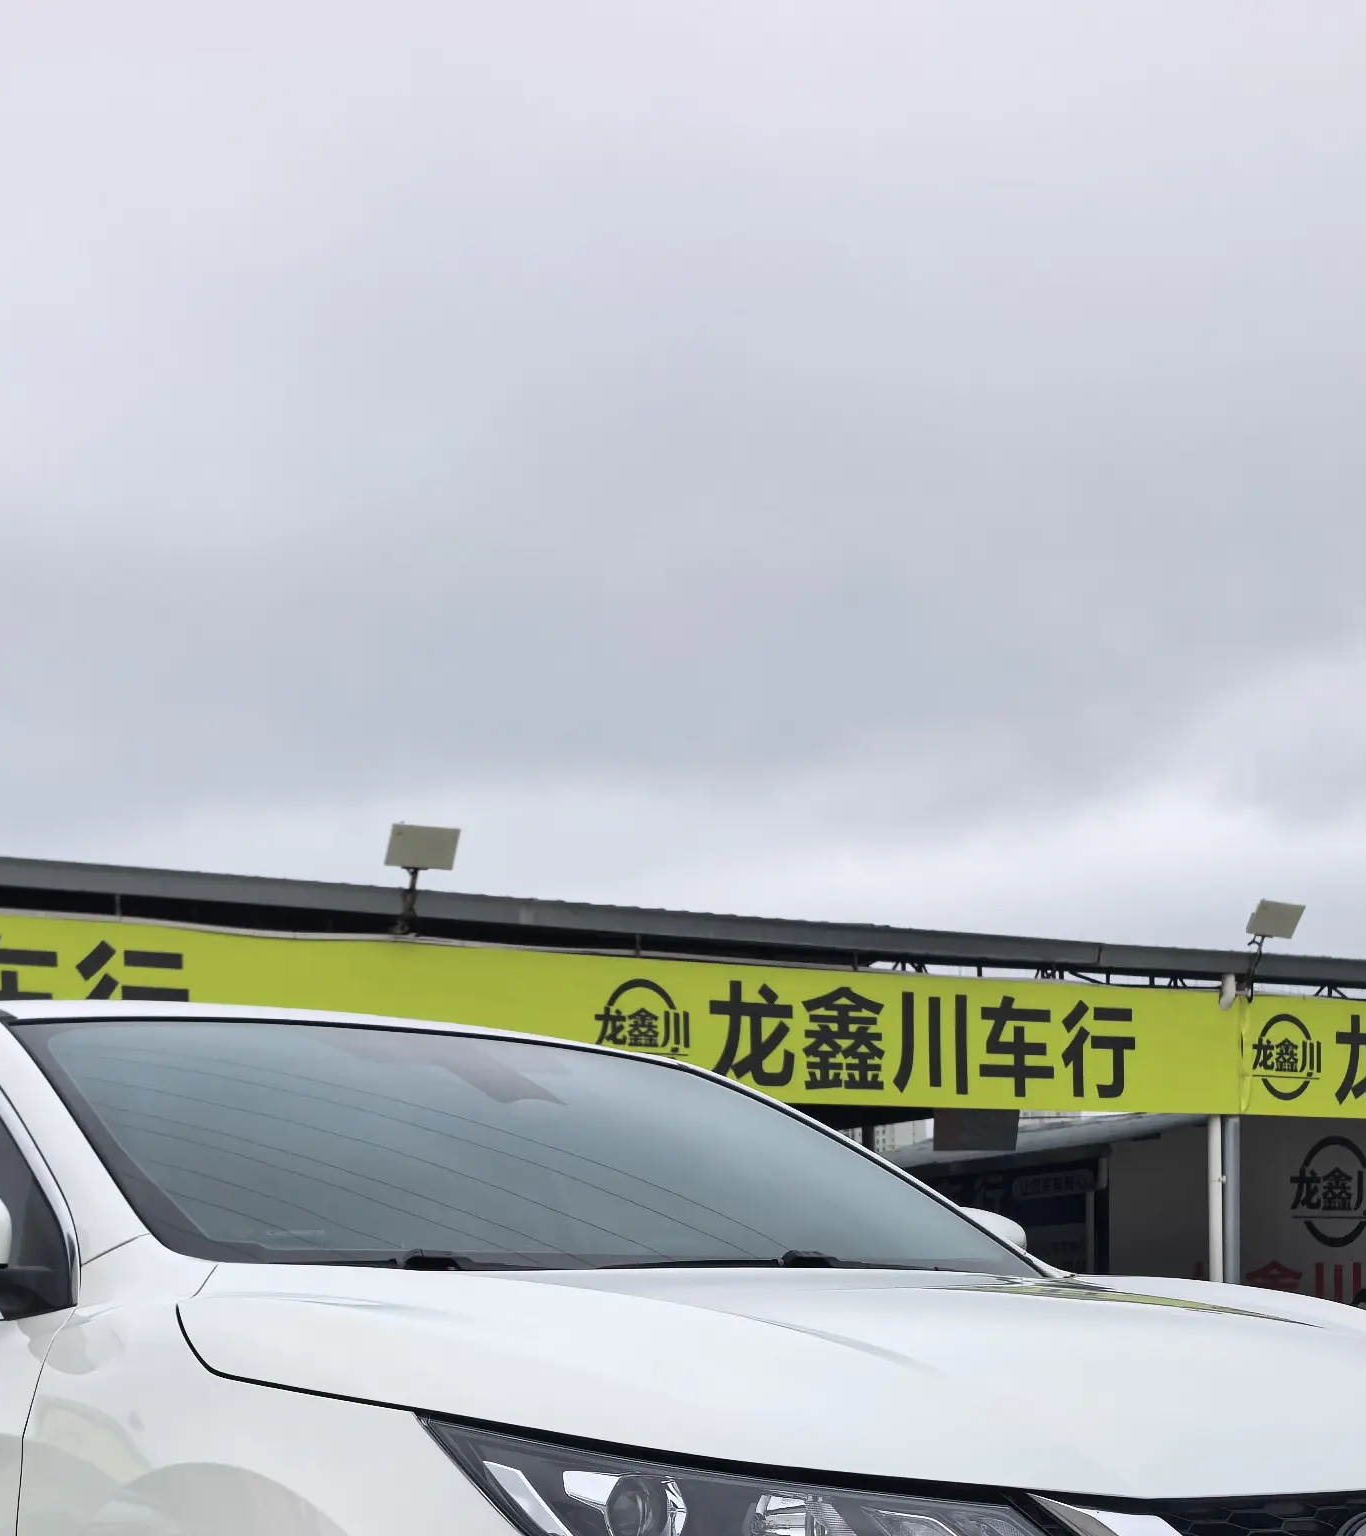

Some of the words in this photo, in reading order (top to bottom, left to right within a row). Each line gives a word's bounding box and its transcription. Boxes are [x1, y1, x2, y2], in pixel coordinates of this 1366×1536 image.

[594, 1006, 690, 1049] 龙鑫川
[708, 979, 1136, 1099] 龙鑫川车行
[1251, 1036, 1322, 1074] 龙鑫川
